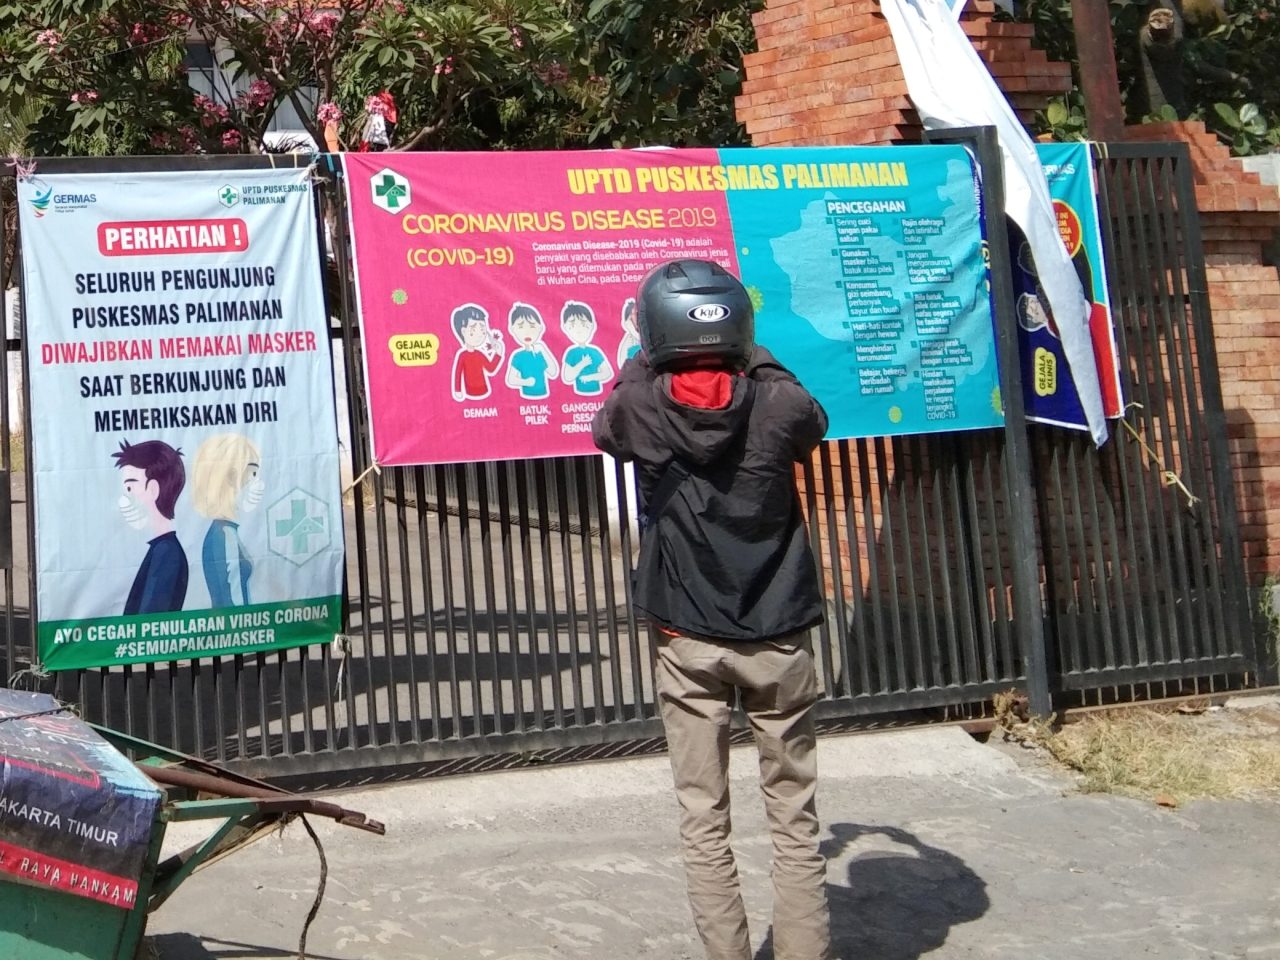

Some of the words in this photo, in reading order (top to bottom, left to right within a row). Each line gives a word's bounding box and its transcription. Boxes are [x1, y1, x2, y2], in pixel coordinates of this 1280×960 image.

[242, 185, 262, 194] UPTD
[264, 184, 308, 194] PUSKESMAS
[567, 167, 631, 195] UPTD
[636, 163, 780, 193] PUSKESMAS
[783, 162, 909, 189] PALIMANAN
[54, 194, 97, 204] GERMAS
[243, 196, 286, 205] PALIMANAN
[827, 200, 906, 214] PENCEGAHAN
[402, 211, 565, 235] CORONAVIRUS
[573, 208, 665, 231] DISEASE
[668, 207, 717, 228] 2019
[105, 225, 226, 251] PERHATIAN
[532, 242, 581, 251] Coronavirus
[406, 245, 514, 268] (COVID-19)
[75, 271, 155, 294] SELURUH
[162, 266, 275, 290] PENGUNJUNG
[547, 275, 576, 284] Wuhan
[73, 303, 179, 328] PUSKESMAS
[186, 299, 283, 324] PALIMANAN
[41, 339, 153, 365] DIWAJIBKAN
[160, 335, 242, 359] MEMAKAI
[248, 331, 316, 354] MASKER
[395, 340, 432, 349] GEJALA
[399, 351, 431, 361] KLINIS
[80, 375, 123, 398] SAAT
[130, 369, 246, 396] BERKUNJUNG
[252, 366, 286, 388] DAN
[95, 406, 237, 432] MEMERIKSAKAN
[243, 401, 278, 423] DIRI
[463, 407, 498, 418] DEMAM
[561, 402, 604, 413] GANGGU
[525, 415, 548, 425] PILEK
[54, 627, 82, 644] AYO
[87, 622, 136, 641] CEGAH
[141, 616, 225, 637] PENULARAN
[230, 610, 270, 628] VIRUS
[274, 604, 329, 624] CORONA
[115, 629, 275, 658] #SEMUAPAKAIMASKER
[68, 818, 118, 847] TIMUR
[70, 873, 134, 904] HANKAM
